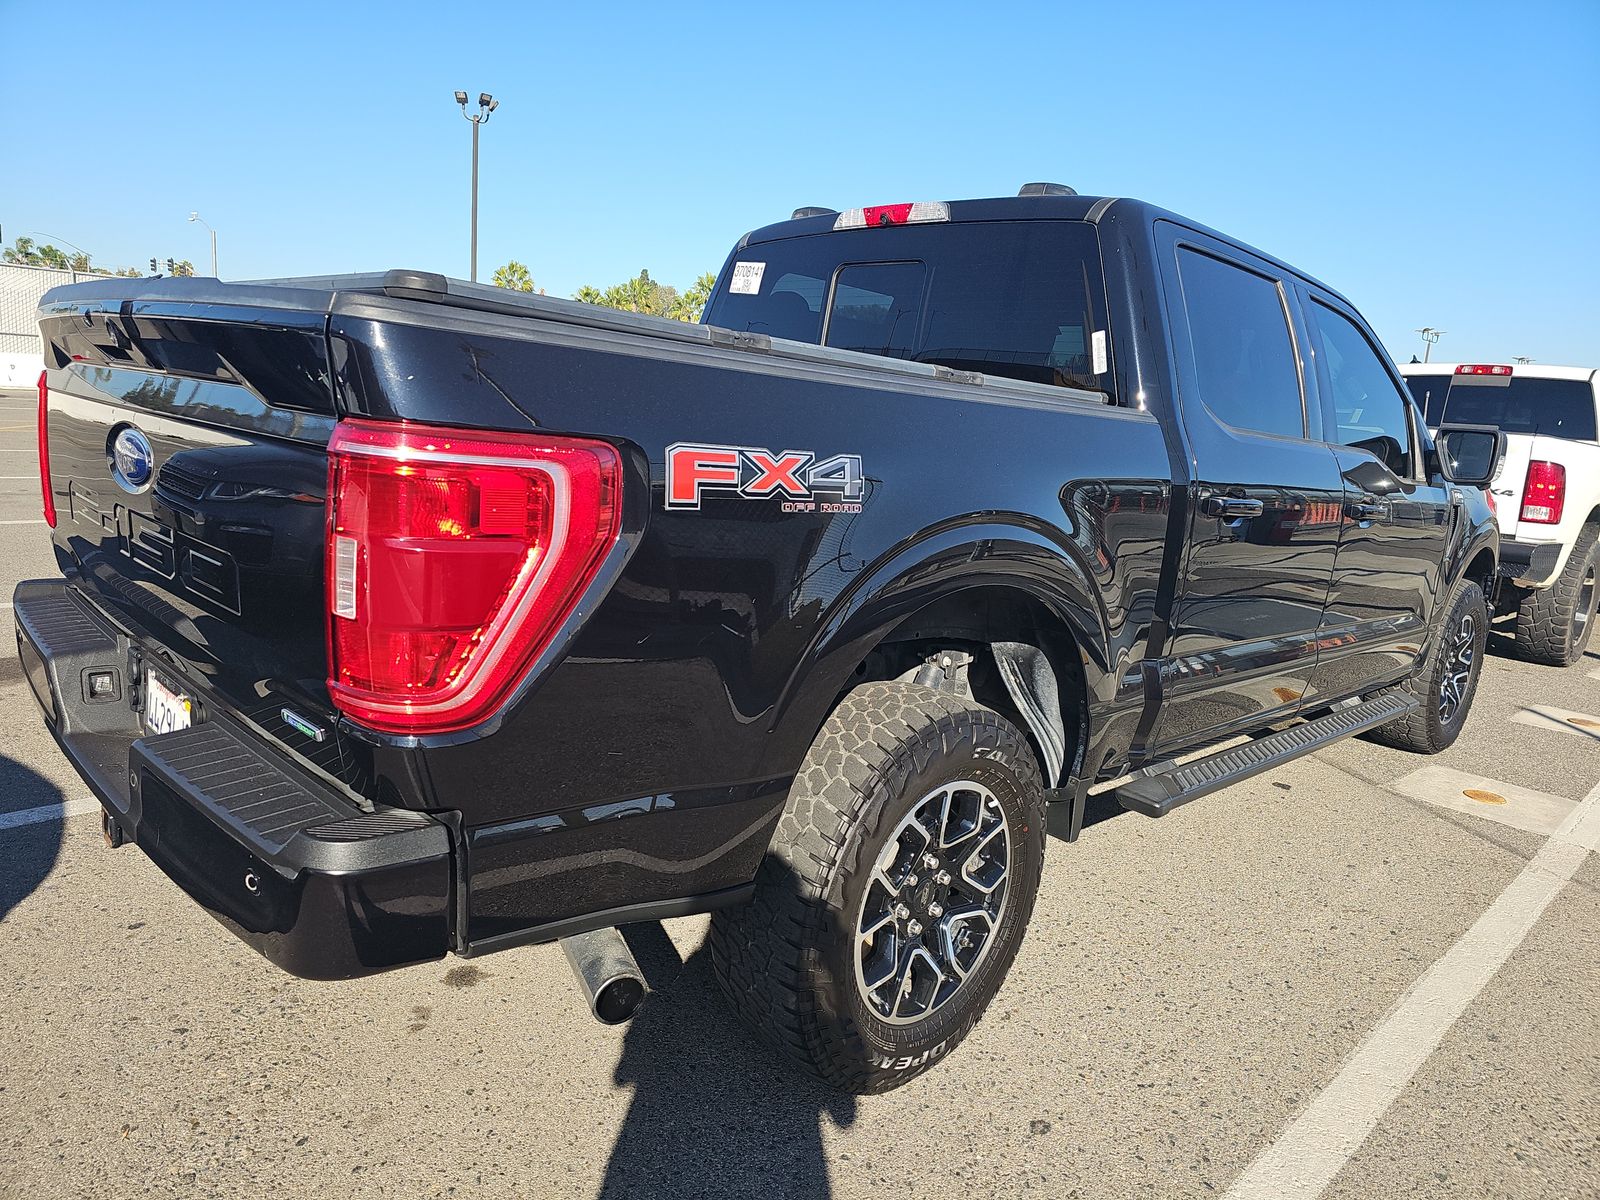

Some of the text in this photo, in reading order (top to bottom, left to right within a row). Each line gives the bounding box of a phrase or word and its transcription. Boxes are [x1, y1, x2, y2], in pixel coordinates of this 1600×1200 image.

[665, 442, 865, 511] FX4
[781, 503, 863, 513] OFF ROAD
